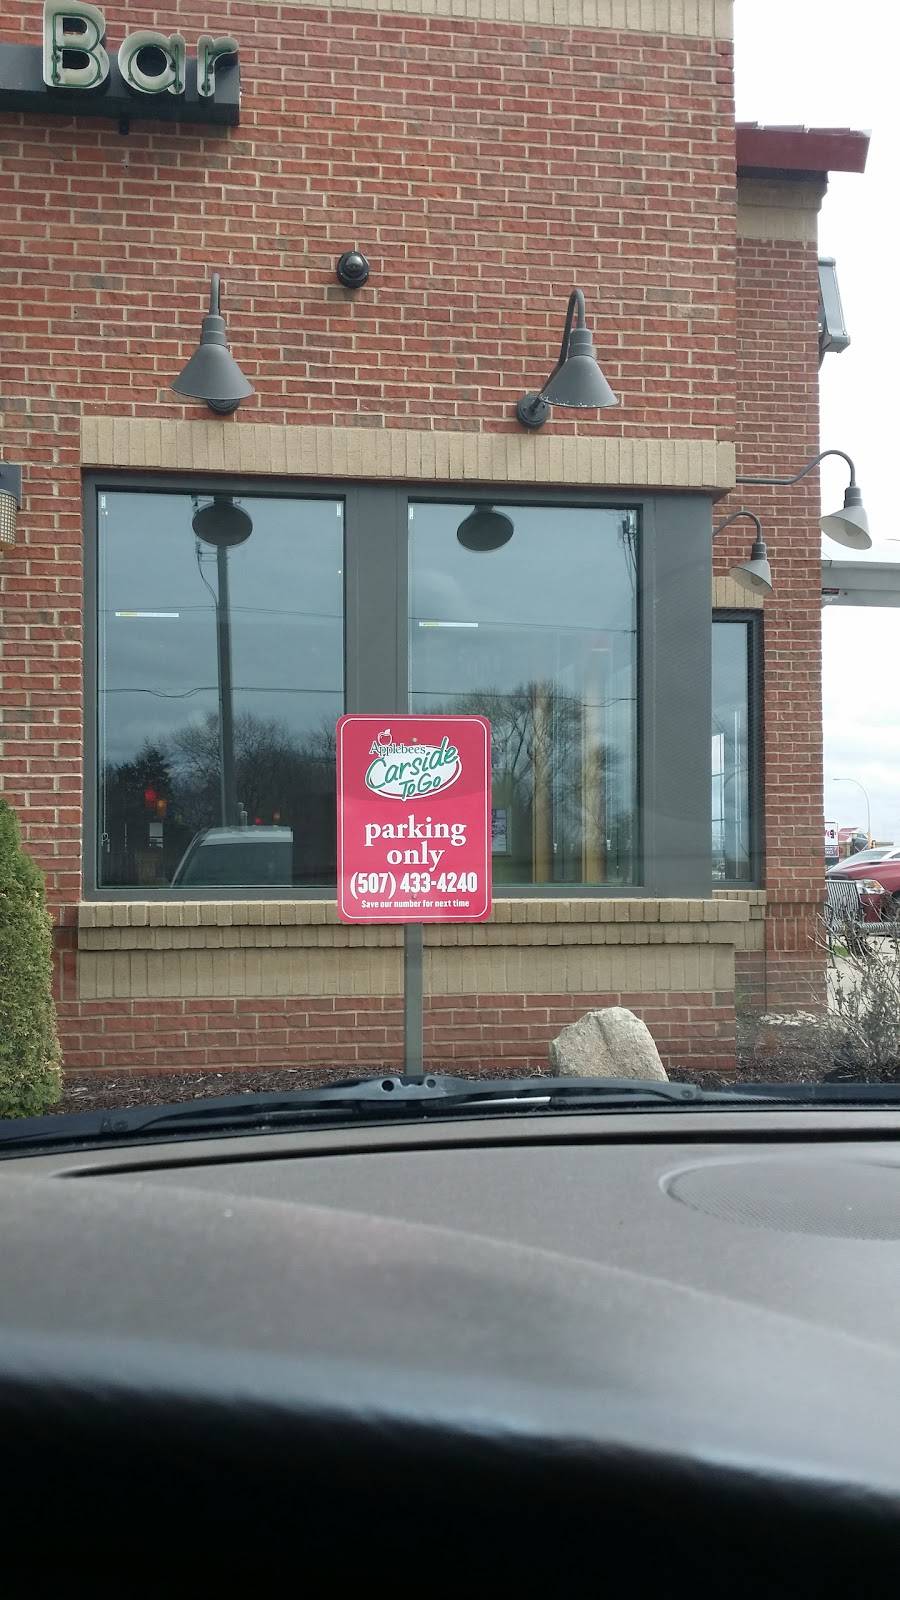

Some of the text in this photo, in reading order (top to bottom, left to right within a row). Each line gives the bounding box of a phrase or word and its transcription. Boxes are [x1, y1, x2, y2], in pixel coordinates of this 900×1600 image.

[43, 0, 239, 97] Bar
[367, 737, 459, 790] Carside
[400, 773, 441, 800] To Go
[365, 815, 467, 847] parking
[387, 841, 445, 872] only
[350, 872, 478, 899] (507) 433-4240
[361, 899, 379, 908] Save
[394, 899, 421, 908] number
[423, 899, 433, 908] for
[435, 900, 451, 908] next
[453, 899, 470, 908] time
